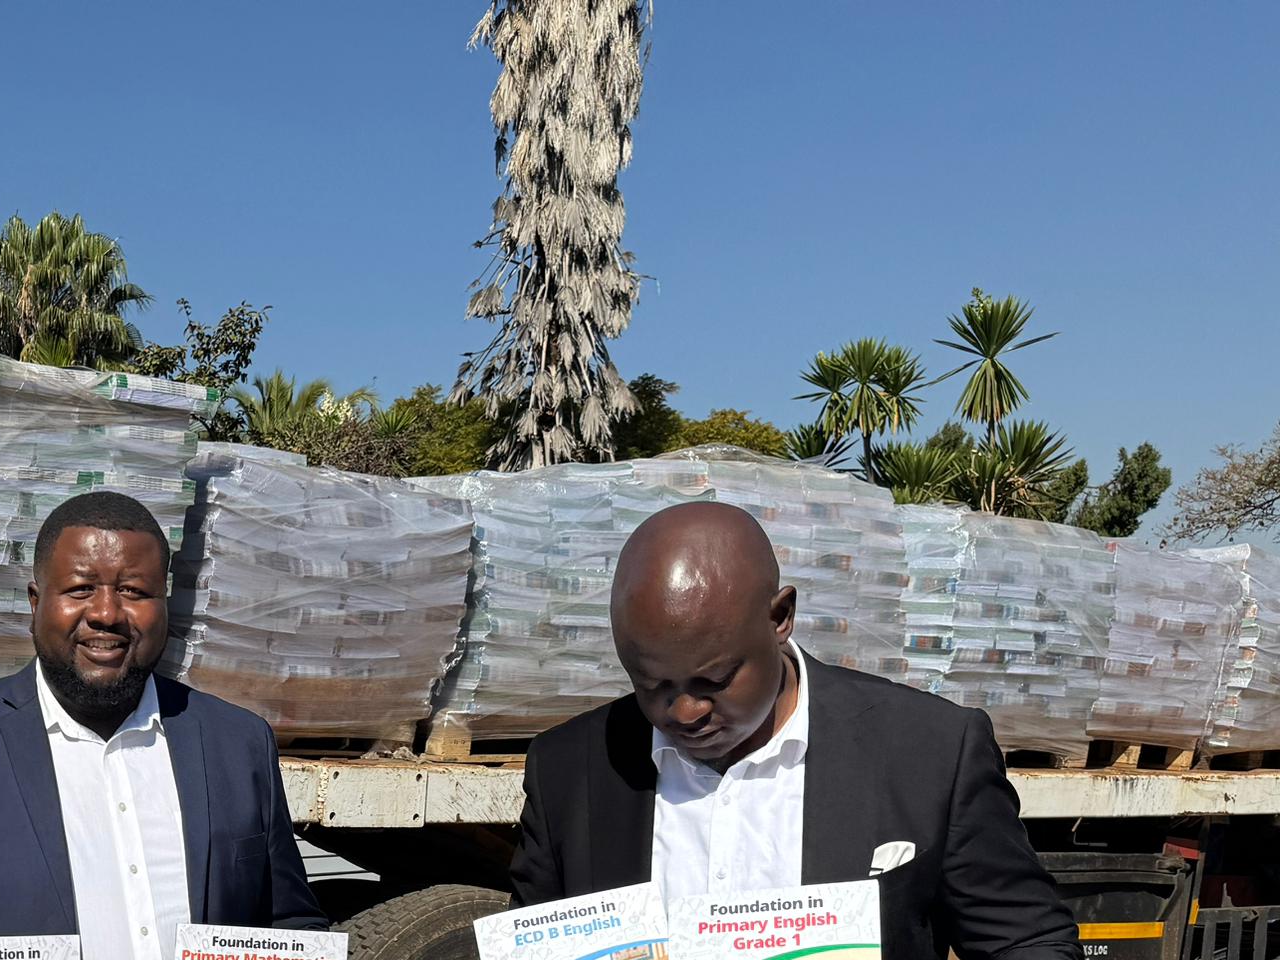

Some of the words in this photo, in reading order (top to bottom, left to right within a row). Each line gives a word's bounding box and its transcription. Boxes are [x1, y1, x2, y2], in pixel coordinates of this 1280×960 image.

[514, 905, 598, 930] Foundation
[601, 901, 616, 913] in
[710, 898, 803, 916] Foundation
[808, 896, 824, 909] in
[515, 930, 546, 947] ECD
[549, 927, 560, 939] B
[563, 916, 621, 936] English
[698, 919, 769, 936] Primary
[774, 912, 838, 932] English
[212, 936, 288, 950] Foundation
[291, 939, 304, 951] in
[733, 936, 787, 950] Grade
[793, 934, 802, 946] 1
[28, 948, 41, 959] in
